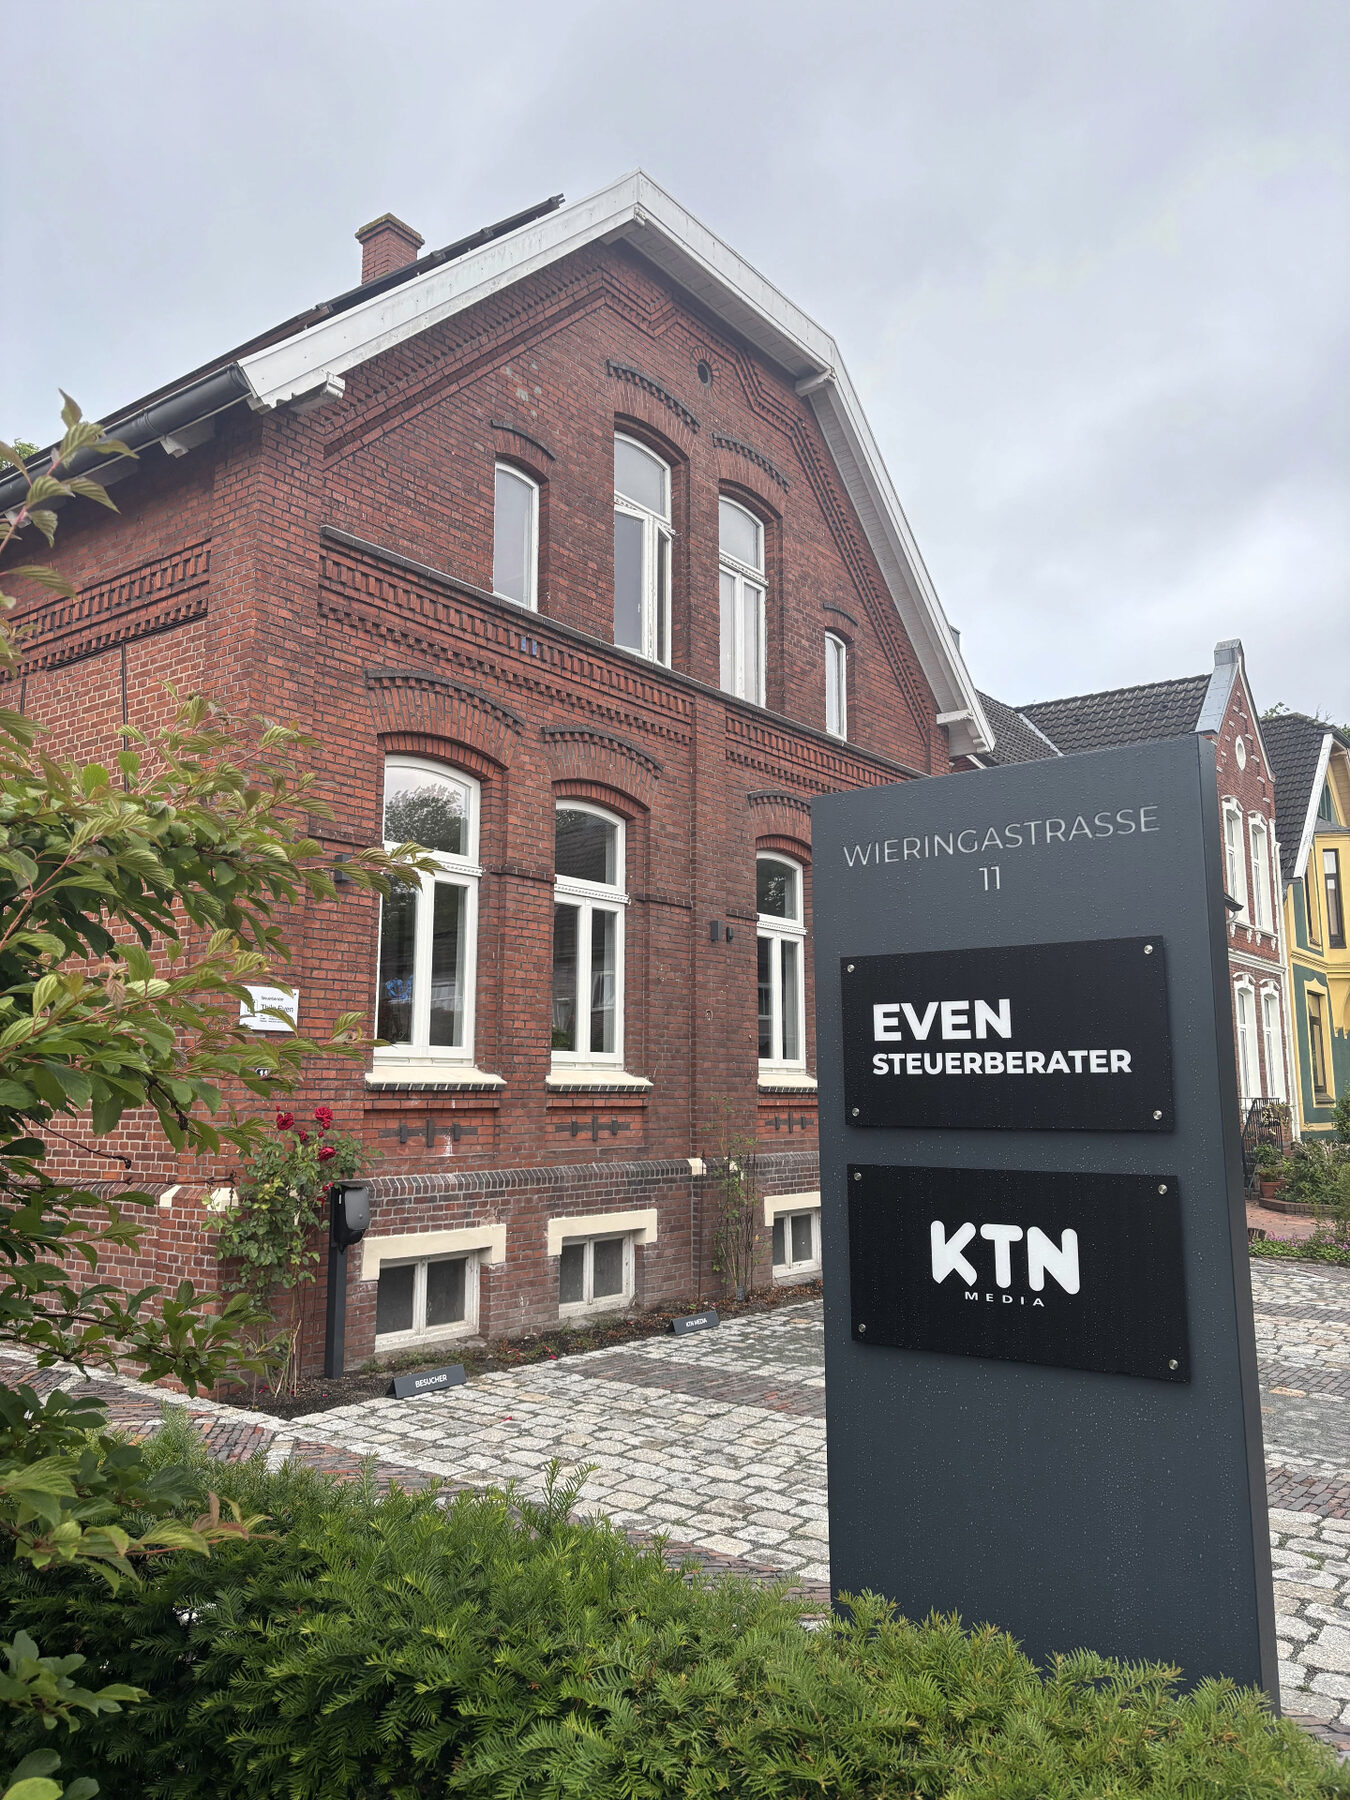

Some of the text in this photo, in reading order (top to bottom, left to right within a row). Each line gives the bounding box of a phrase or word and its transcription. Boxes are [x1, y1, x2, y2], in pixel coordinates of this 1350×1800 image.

[843, 805, 1161, 867] WIERINGASTRASSE
[978, 866, 1001, 891] 11
[873, 999, 1012, 1042] EVEN
[872, 1049, 1133, 1075] STEUERBERATER
[930, 1219, 1081, 1296] KTN
[964, 1291, 1045, 1308] MEDIA
[415, 1374, 448, 1388] BESUCHER
